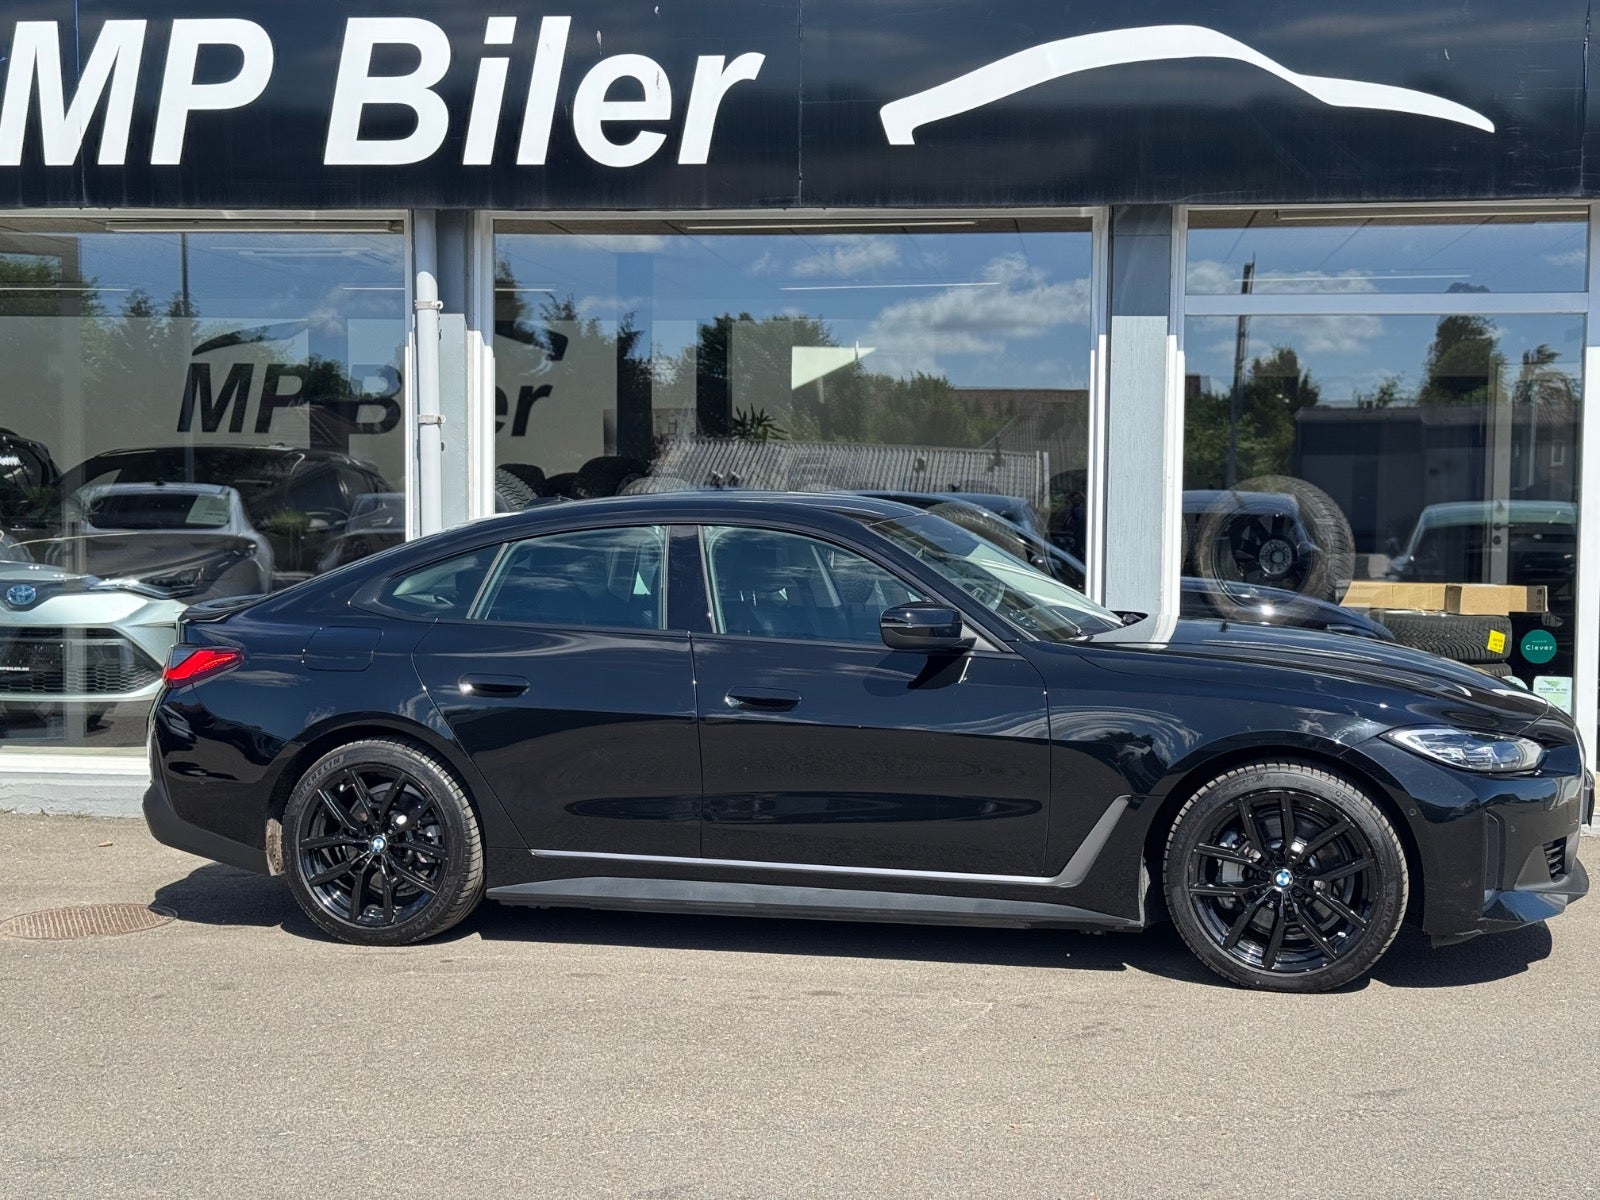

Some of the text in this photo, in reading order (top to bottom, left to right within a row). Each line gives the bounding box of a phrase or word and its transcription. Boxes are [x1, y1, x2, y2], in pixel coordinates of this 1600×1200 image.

[0, 15, 766, 168] MP Biler
[177, 363, 311, 433] MP
[298, 757, 342, 801] MICHELIN
